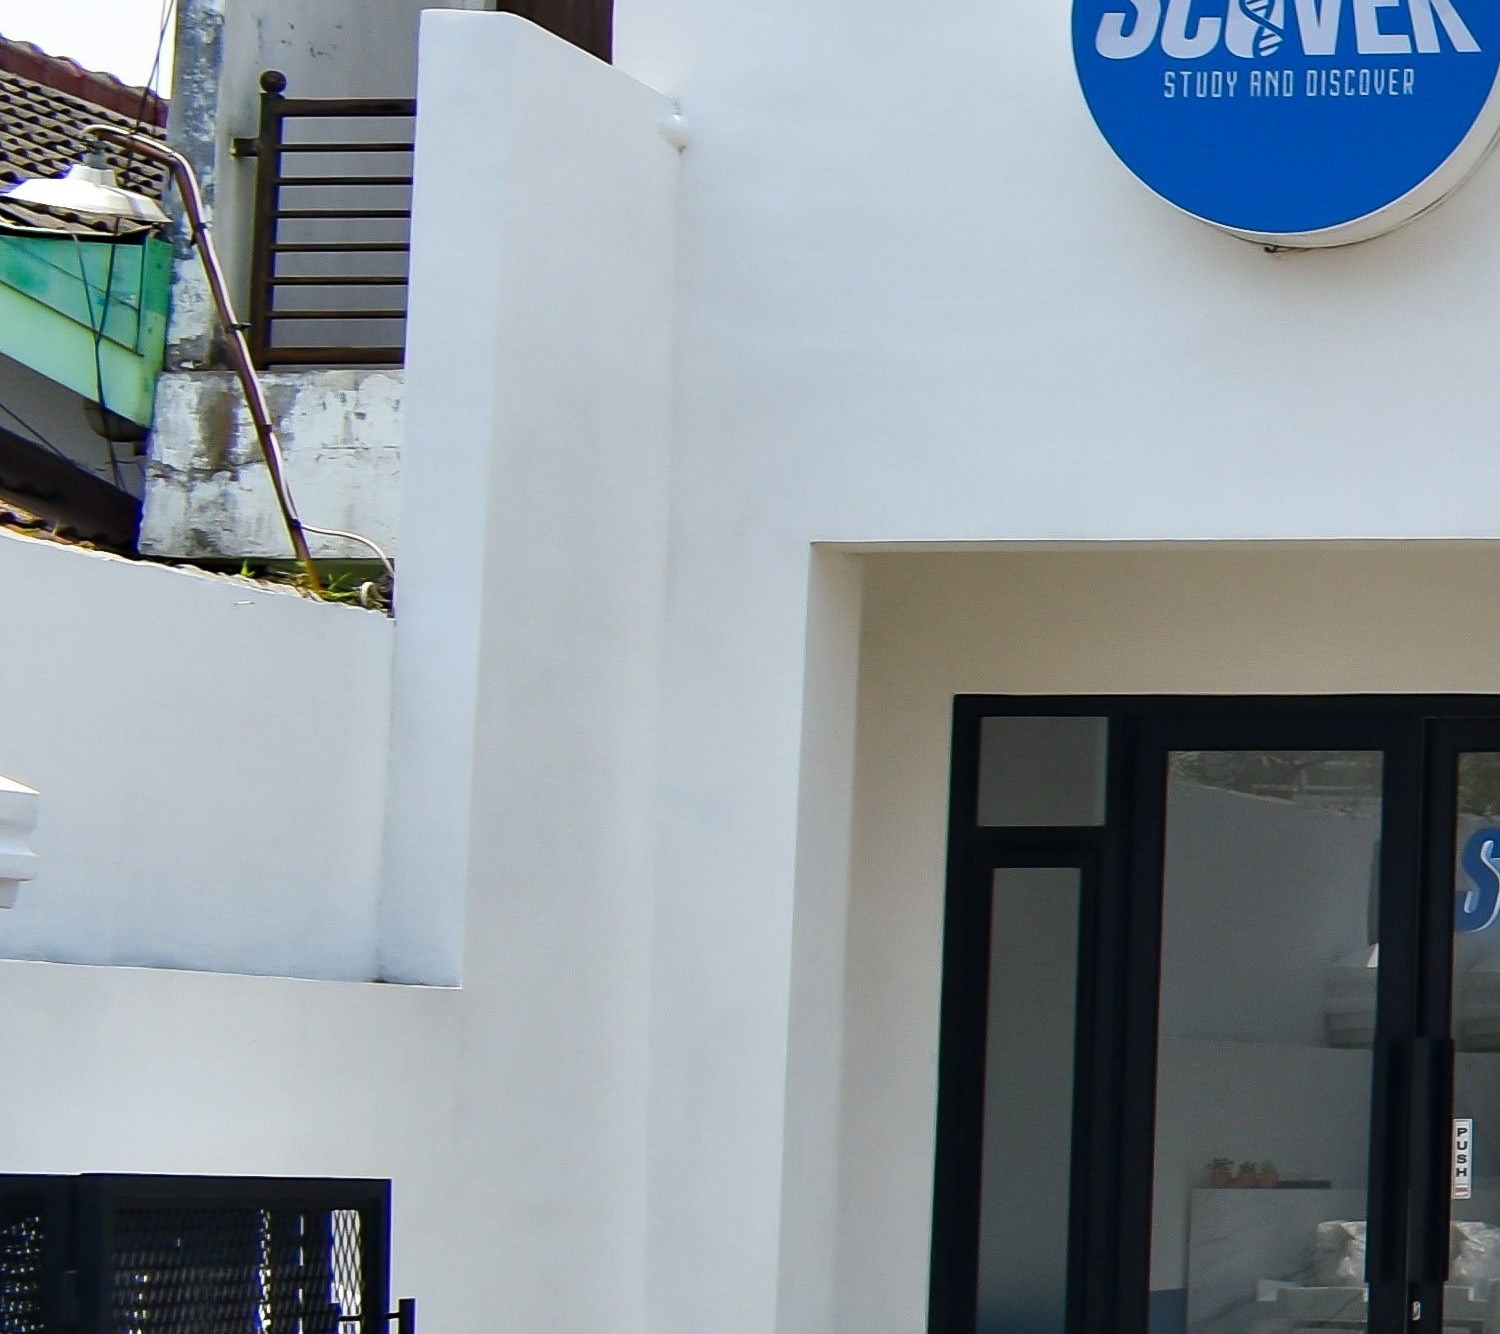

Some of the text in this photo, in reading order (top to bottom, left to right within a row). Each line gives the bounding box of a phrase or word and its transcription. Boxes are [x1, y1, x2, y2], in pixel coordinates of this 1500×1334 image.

[1164, 68, 1415, 98] STUDY AND DISCOVER
[1456, 1127, 1468, 1177] PUSH
